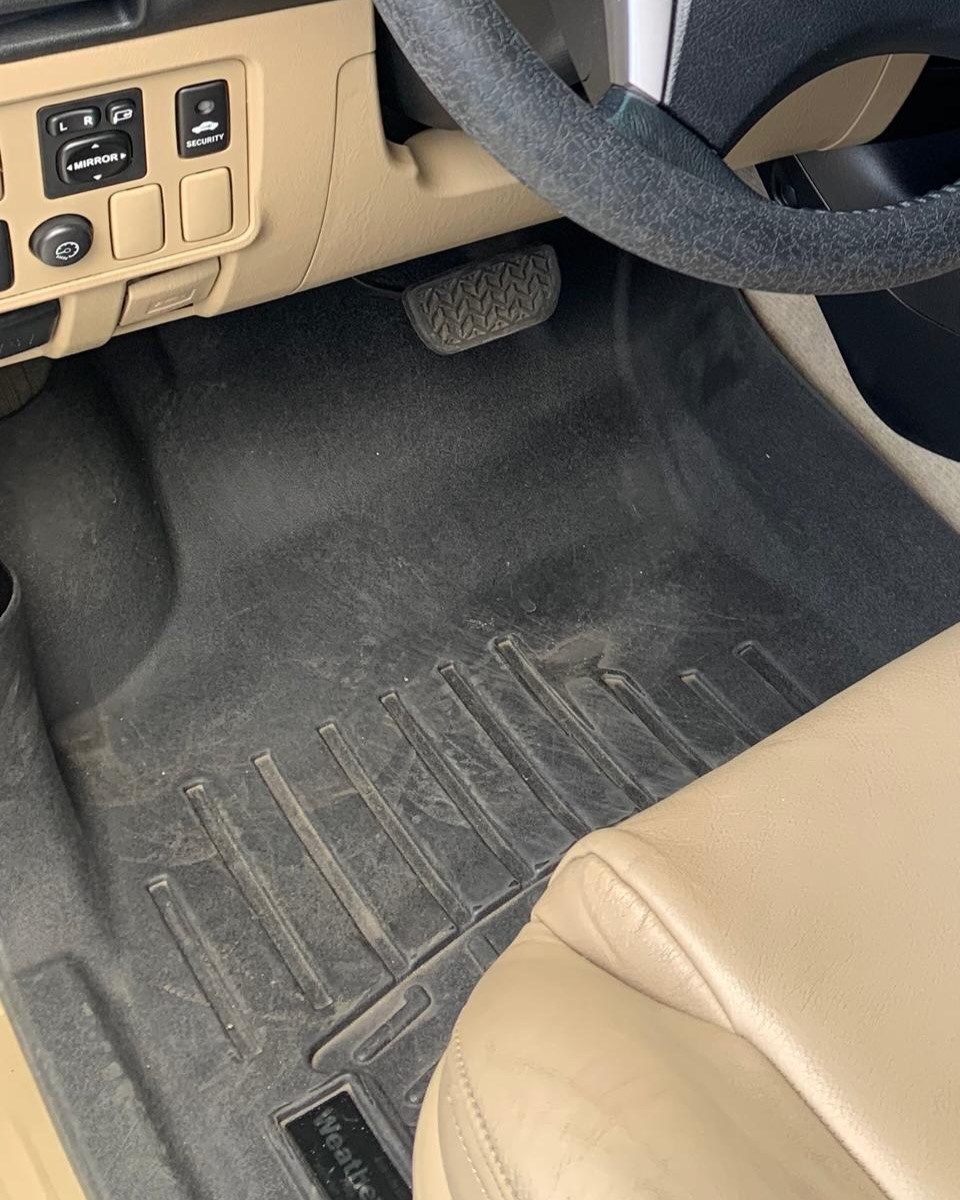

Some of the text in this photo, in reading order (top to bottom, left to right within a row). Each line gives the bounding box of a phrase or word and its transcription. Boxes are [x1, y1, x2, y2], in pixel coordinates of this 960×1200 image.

[59, 121, 69, 132] L
[83, 115, 94, 127] R
[186, 133, 226, 149] SECURITY
[74, 153, 119, 171] MIRROR
[313, 1107, 377, 1200] Weathe
